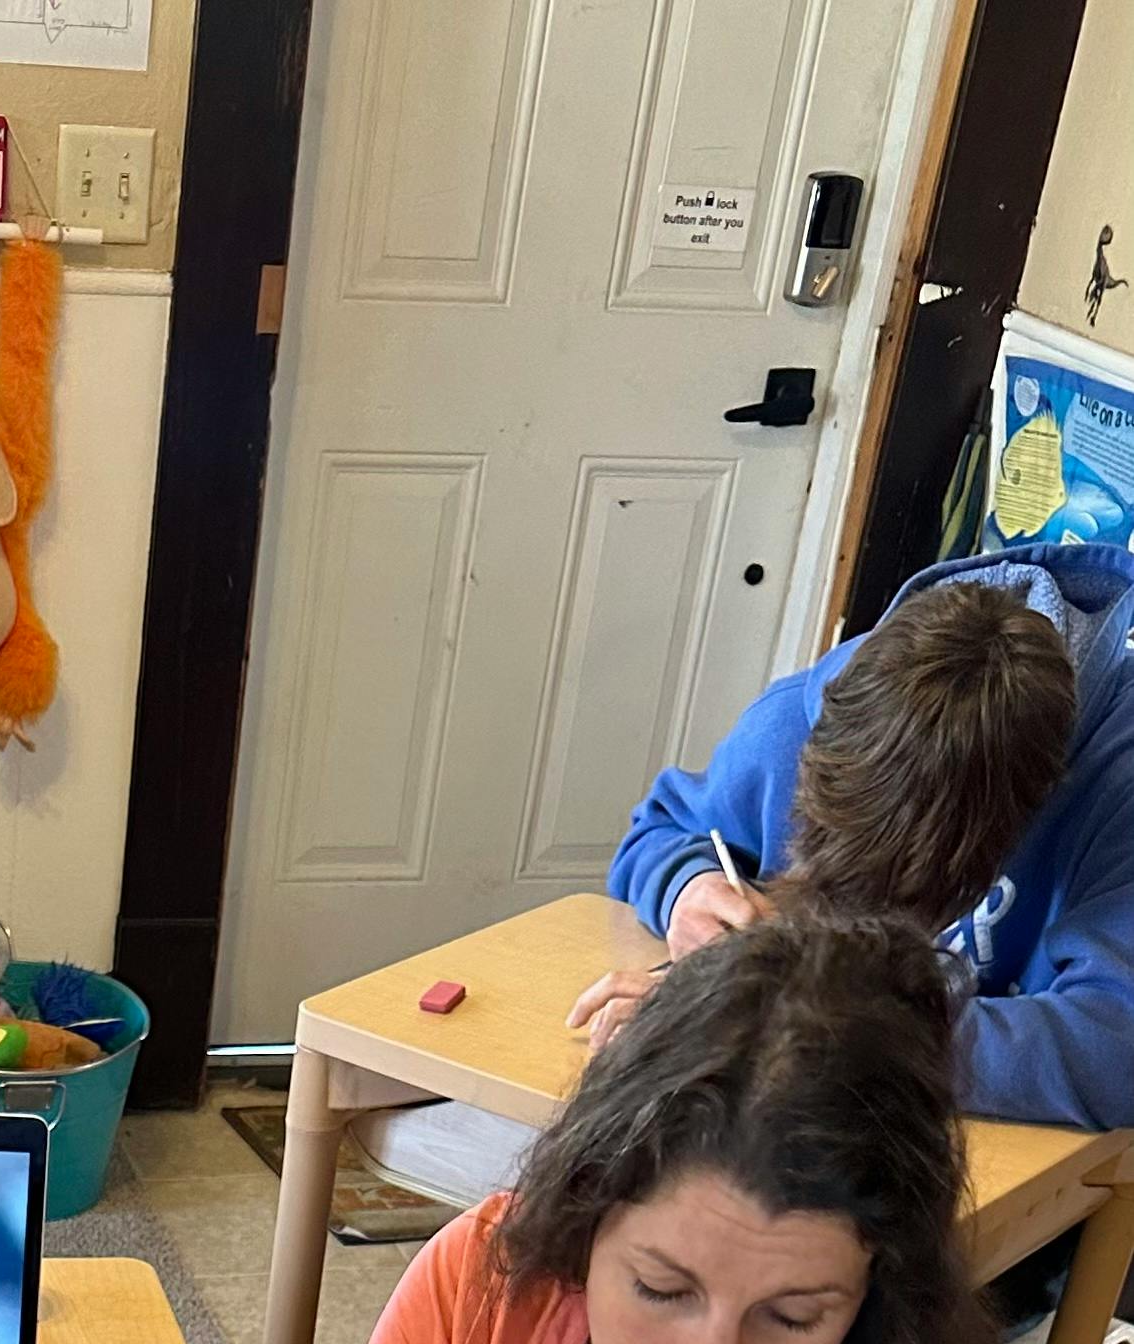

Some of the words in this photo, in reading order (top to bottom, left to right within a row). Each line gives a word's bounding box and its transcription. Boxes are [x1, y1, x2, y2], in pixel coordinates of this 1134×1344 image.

[675, 195, 702, 208] Push
[716, 198, 738, 210] lock
[663, 213, 697, 225] button
[699, 215, 722, 227] after
[724, 218, 744, 230] you
[691, 233, 710, 244] exit
[1100, 407, 1114, 427] on
[1115, 410, 1123, 428] a
